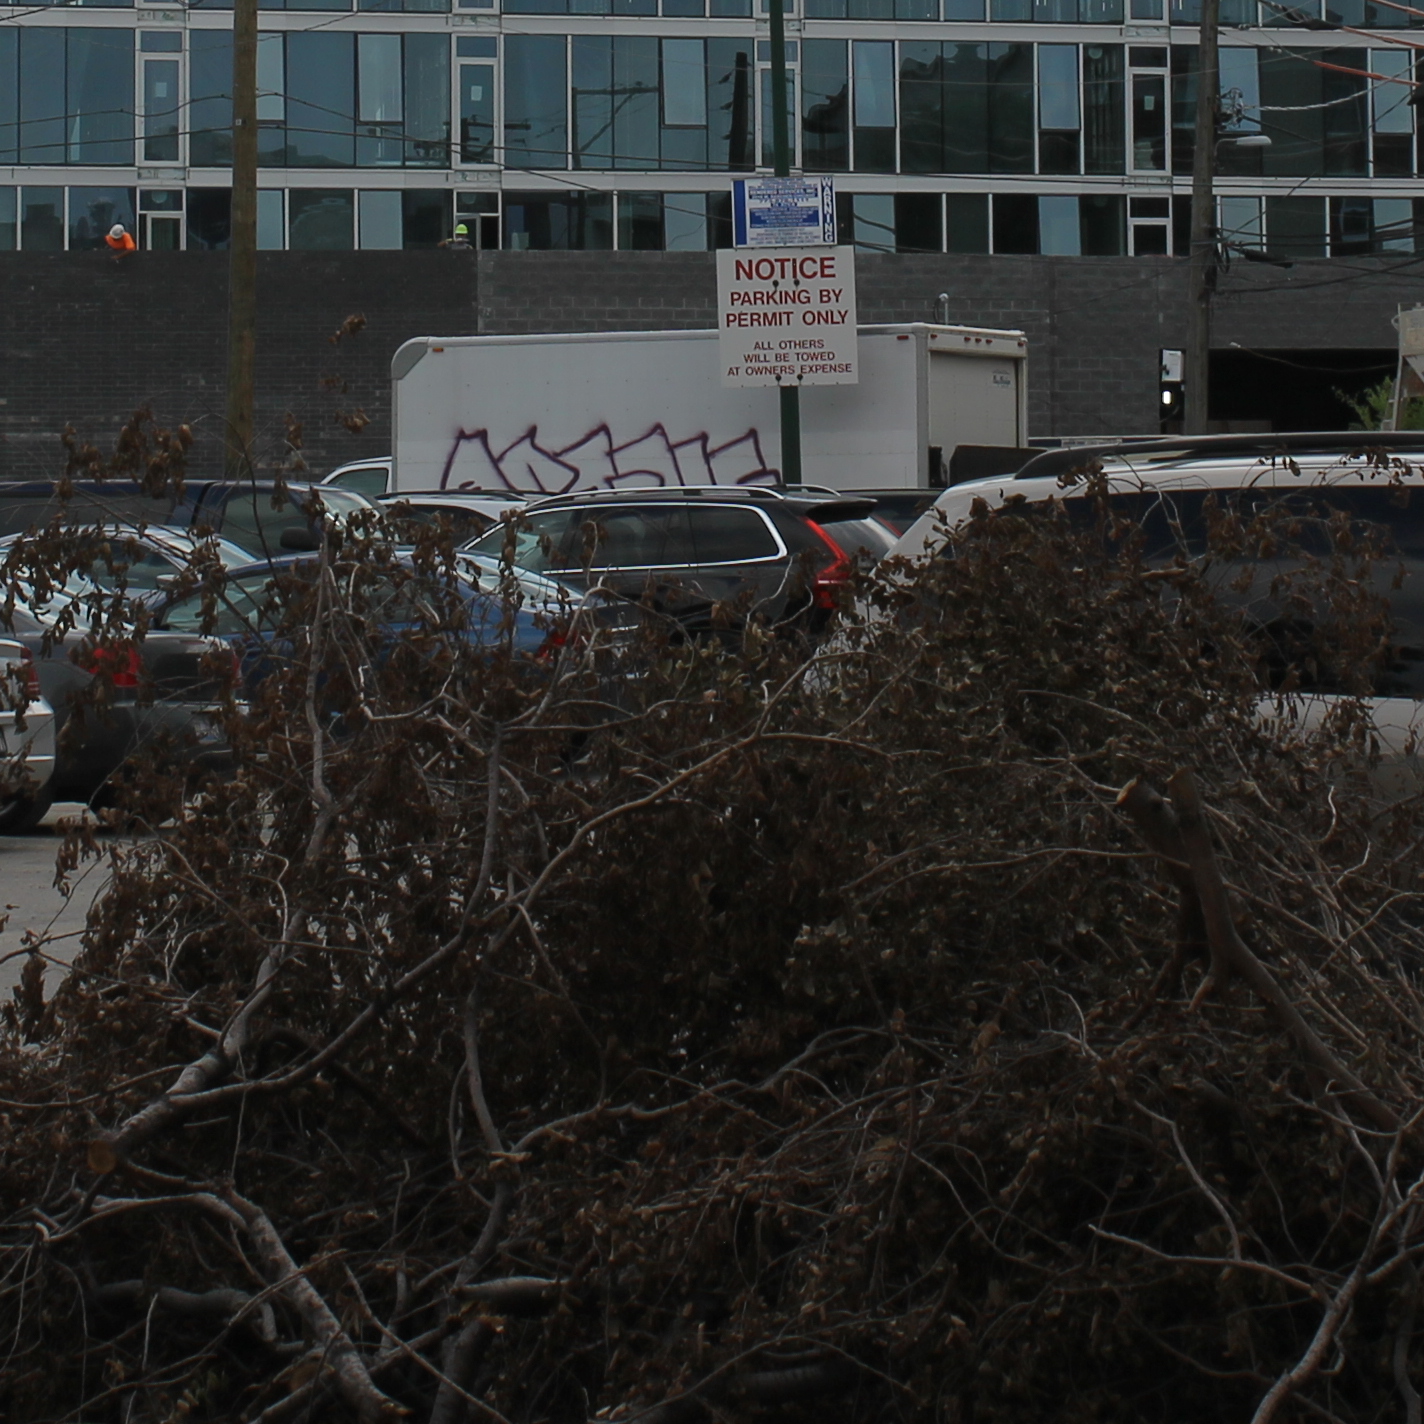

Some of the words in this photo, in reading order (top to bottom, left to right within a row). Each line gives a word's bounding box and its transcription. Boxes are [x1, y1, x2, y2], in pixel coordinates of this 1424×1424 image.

[821, 177, 834, 242] WARNING
[735, 257, 836, 281] NOTICE
[730, 289, 811, 306] PARKING
[819, 288, 843, 304] BY
[726, 311, 794, 328] PERMIT
[802, 309, 848, 326] ONLY
[753, 341, 774, 351] ALL
[779, 339, 825, 350] OTHERS
[743, 354, 770, 363] WILL
[775, 353, 790, 362] BE
[795, 351, 835, 362] TOWED
[727, 366, 740, 376] AT
[745, 364, 795, 376] OWNERS
[800, 363, 852, 374] EXPENSE
